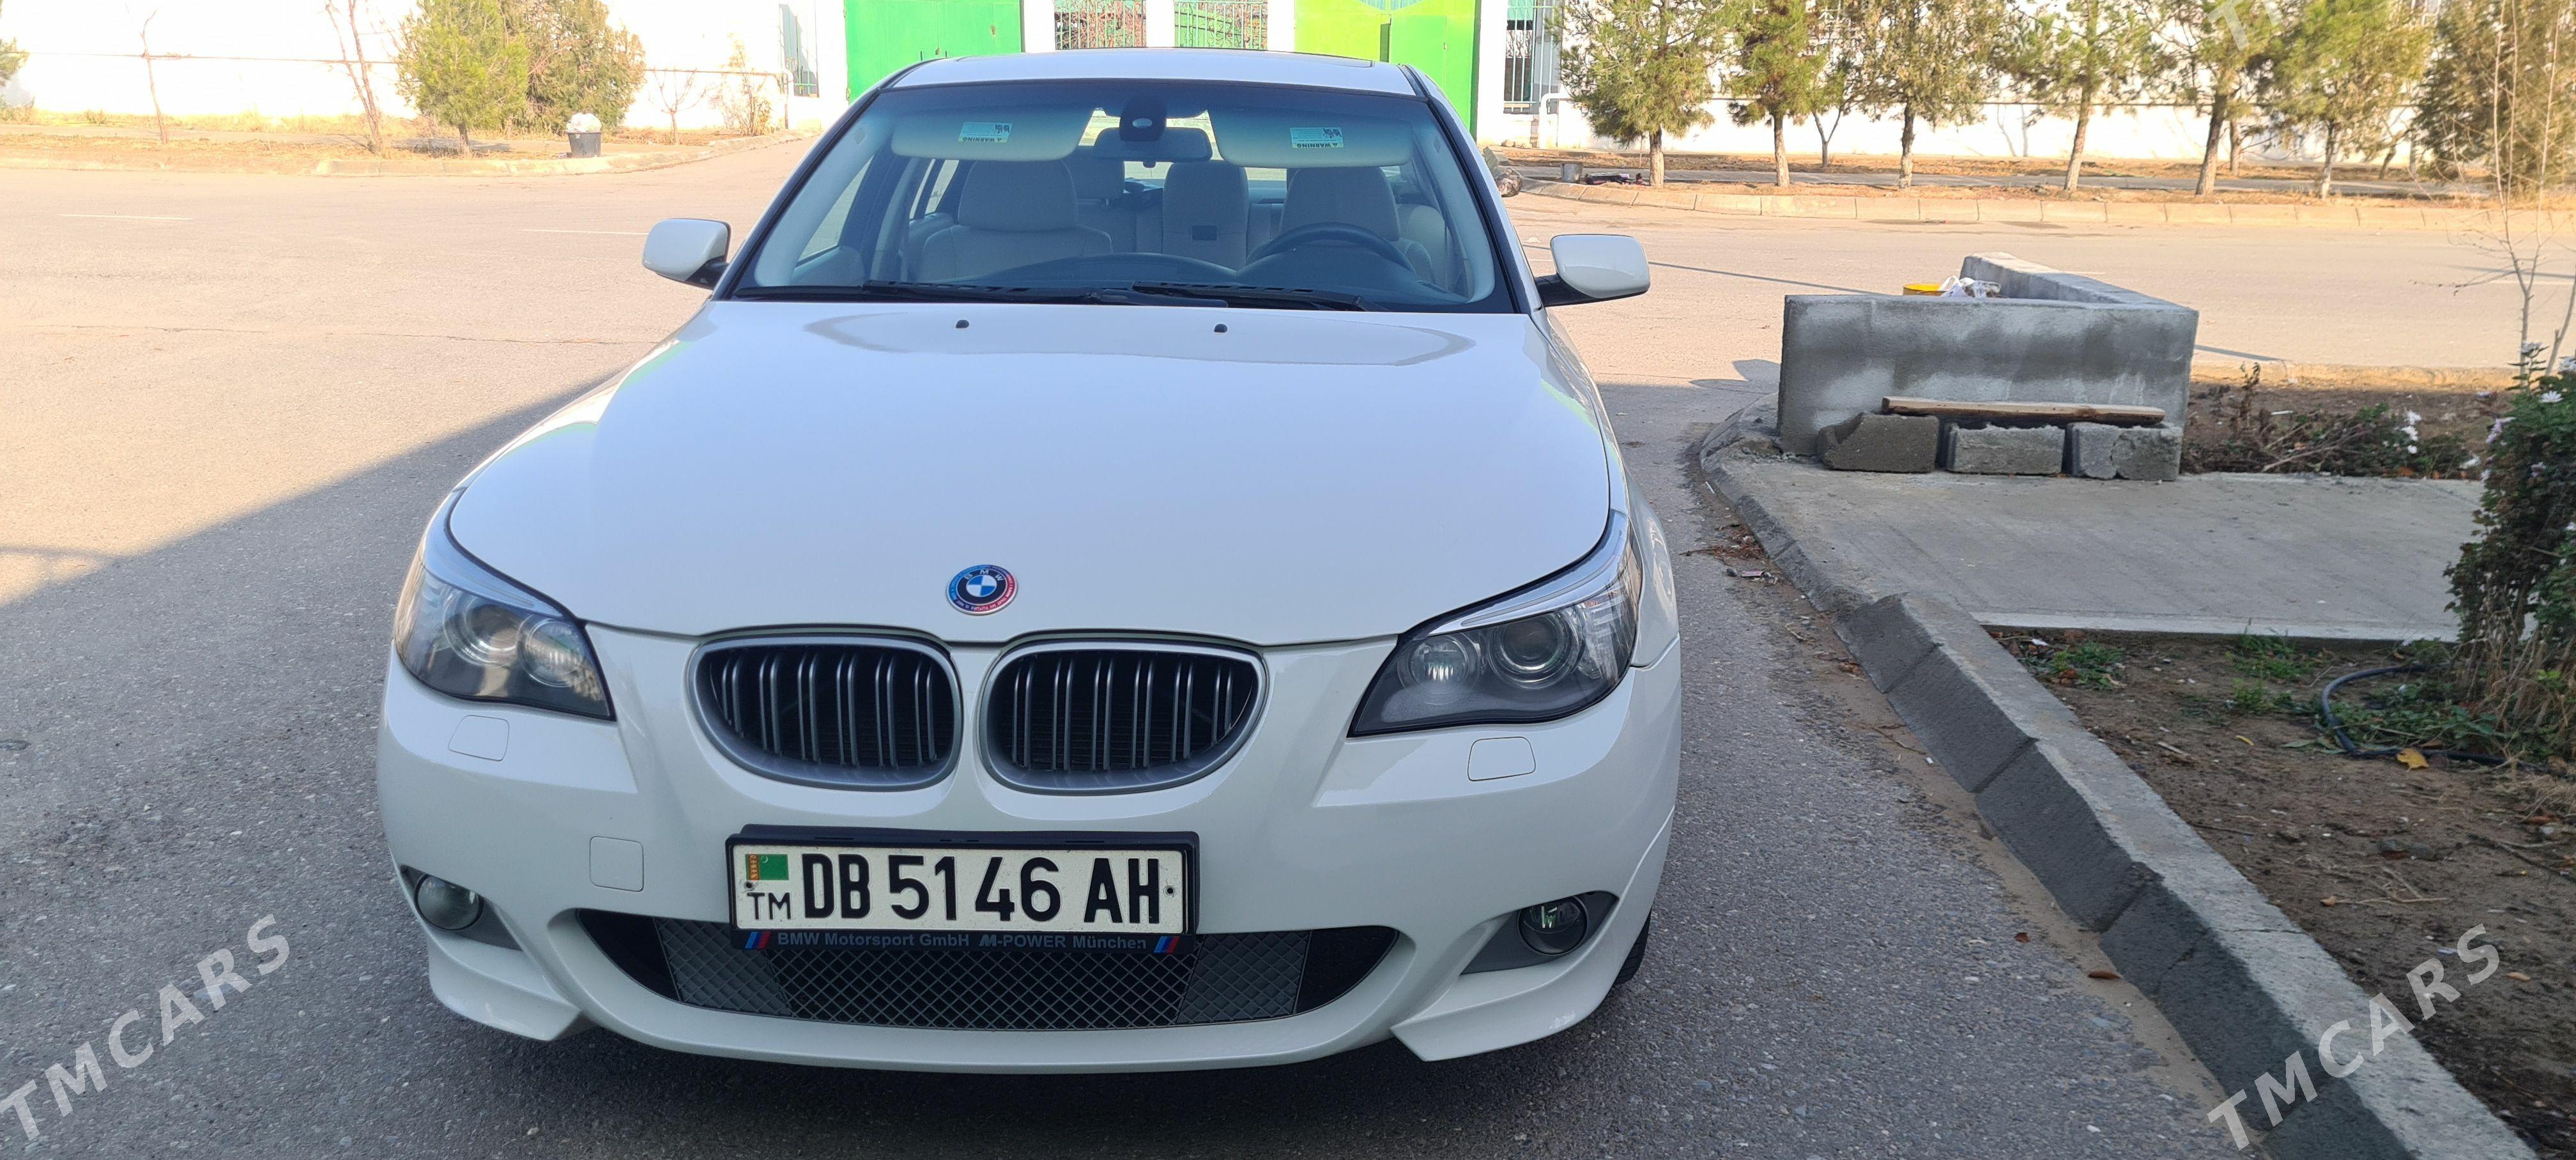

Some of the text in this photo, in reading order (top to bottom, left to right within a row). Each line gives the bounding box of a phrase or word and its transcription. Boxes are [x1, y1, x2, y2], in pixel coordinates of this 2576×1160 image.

[964, 569, 1004, 581] BMW
[801, 853, 1160, 924] DB 5146 AH
[747, 892, 792, 920] TM
[778, 932, 1147, 950] BMW Motorsport GmbH M-POWER München
